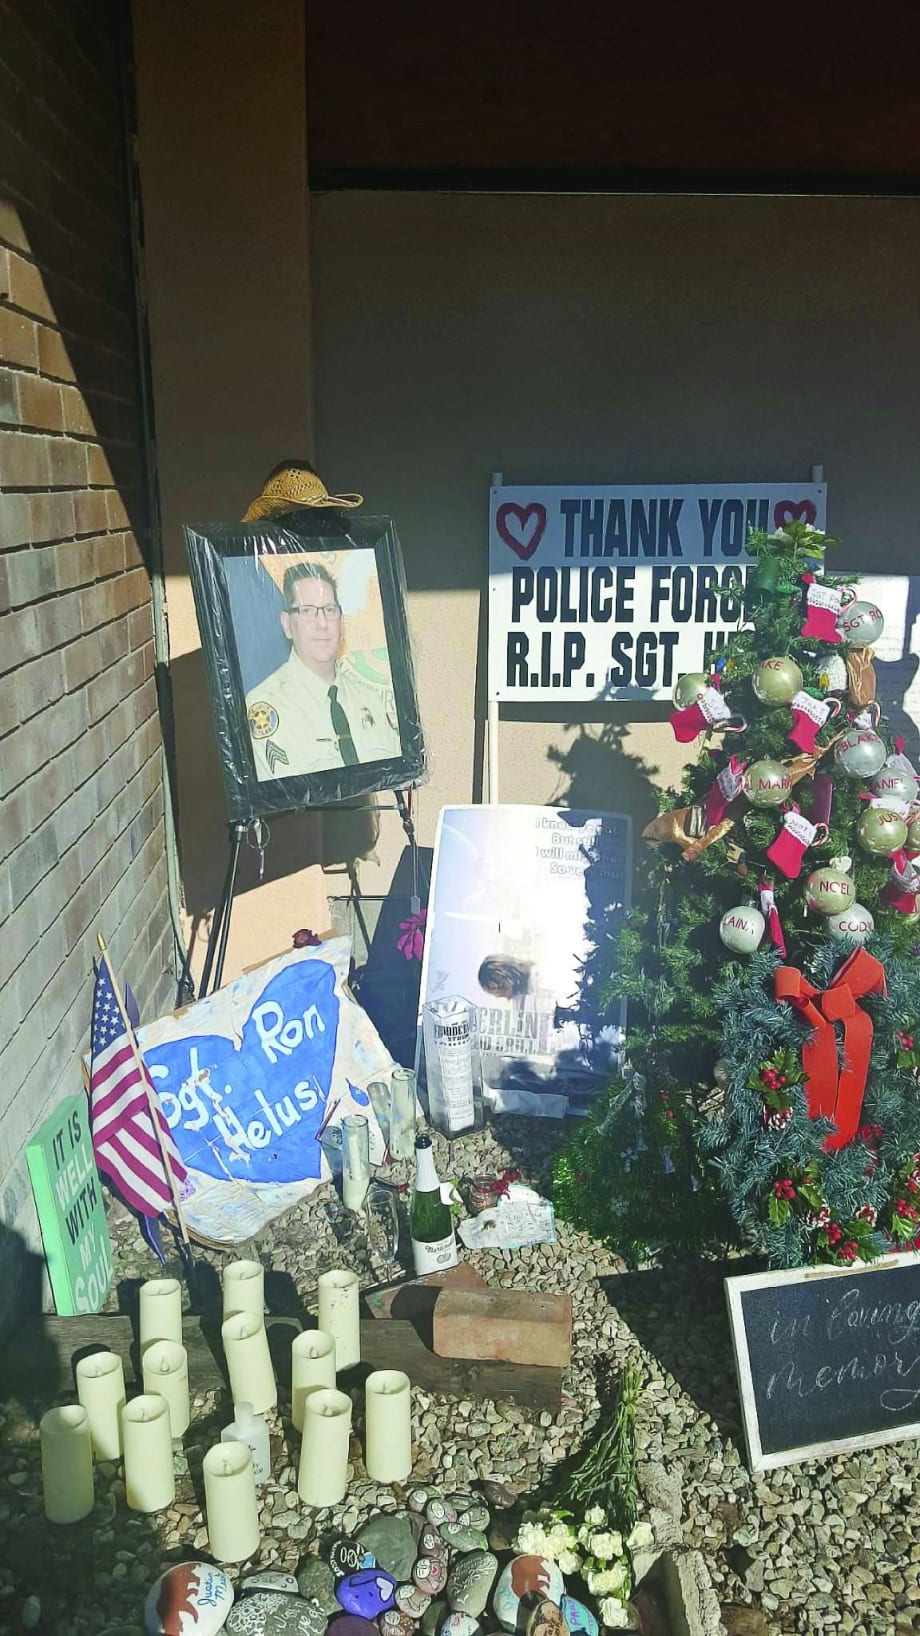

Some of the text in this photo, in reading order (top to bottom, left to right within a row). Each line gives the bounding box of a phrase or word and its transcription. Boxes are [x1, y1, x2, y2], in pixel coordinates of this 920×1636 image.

[560, 499, 685, 557] THANK
[511, 565, 636, 623] POLICE
[843, 614, 865, 632] SGT
[506, 631, 594, 688] R.I.P.
[610, 631, 687, 688] SGT.
[540, 846, 564, 859] will
[819, 880, 851, 897] NOEL
[252, 1001, 326, 1064] Ron
[52, 1110, 82, 1171] IT IS
[55, 1144, 94, 1212] WELL
[65, 1176, 97, 1246] WITH
[74, 1235, 113, 1314] SOUL
[79, 1223, 96, 1272] MY
